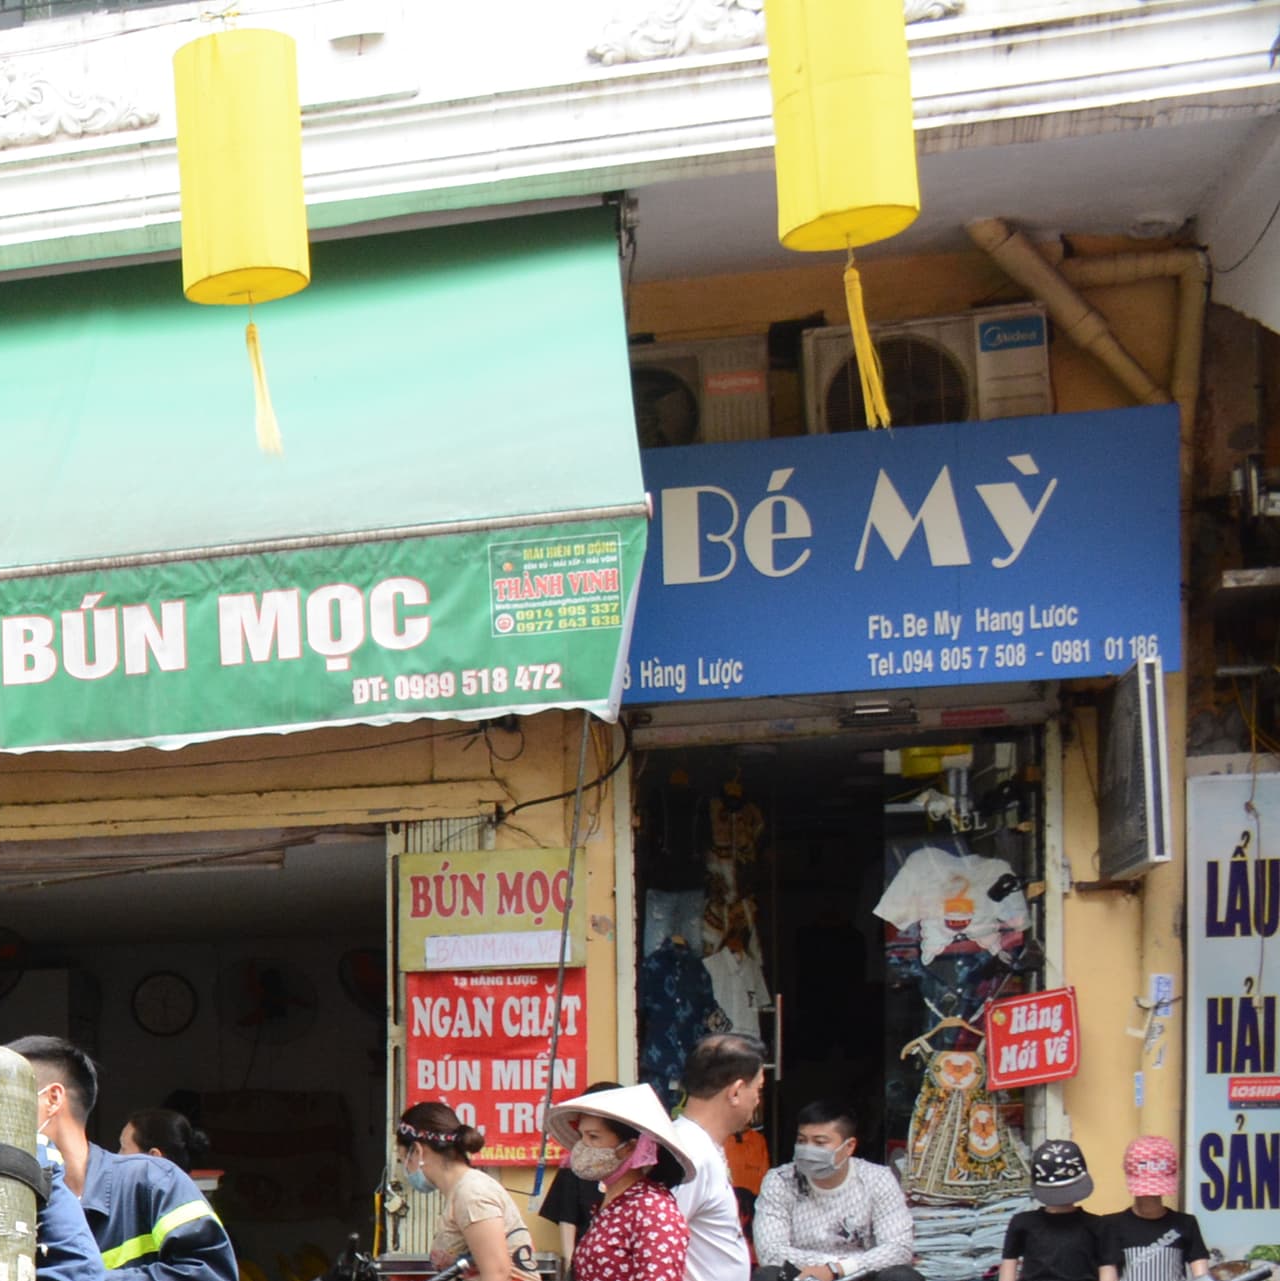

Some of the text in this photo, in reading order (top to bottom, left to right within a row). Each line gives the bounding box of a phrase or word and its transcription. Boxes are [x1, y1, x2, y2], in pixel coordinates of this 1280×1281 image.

[662, 453, 1058, 585] Bé Mỳ
[494, 568, 619, 601] THÀNH VINH
[516, 620, 554, 633] 0977
[592, 602, 619, 614] 337
[934, 610, 962, 641] My
[976, 607, 1025, 637] Hang
[1, 592, 187, 687] BÚN
[217, 576, 432, 671] MỌC
[640, 656, 686, 694] Hàng
[698, 656, 744, 690] Lược
[940, 647, 972, 671] 805
[977, 645, 989, 668] 7
[995, 643, 1026, 668] 508
[1052, 638, 1090, 665] 0981
[1105, 637, 1124, 661] 01
[352, 663, 562, 705] ĐT: 0989 518 472
[409, 861, 575, 926] BÚN MỌC
[1205, 830, 1280, 938] LẨU
[412, 982, 582, 1044] NGAN CHẶT
[1008, 1002, 1063, 1035] Hàng
[1206, 976, 1277, 1074] HẢI
[416, 1054, 481, 1091] BÚN
[998, 1029, 1072, 1074] Mới Về
[1199, 1113, 1280, 1211] SẢN
